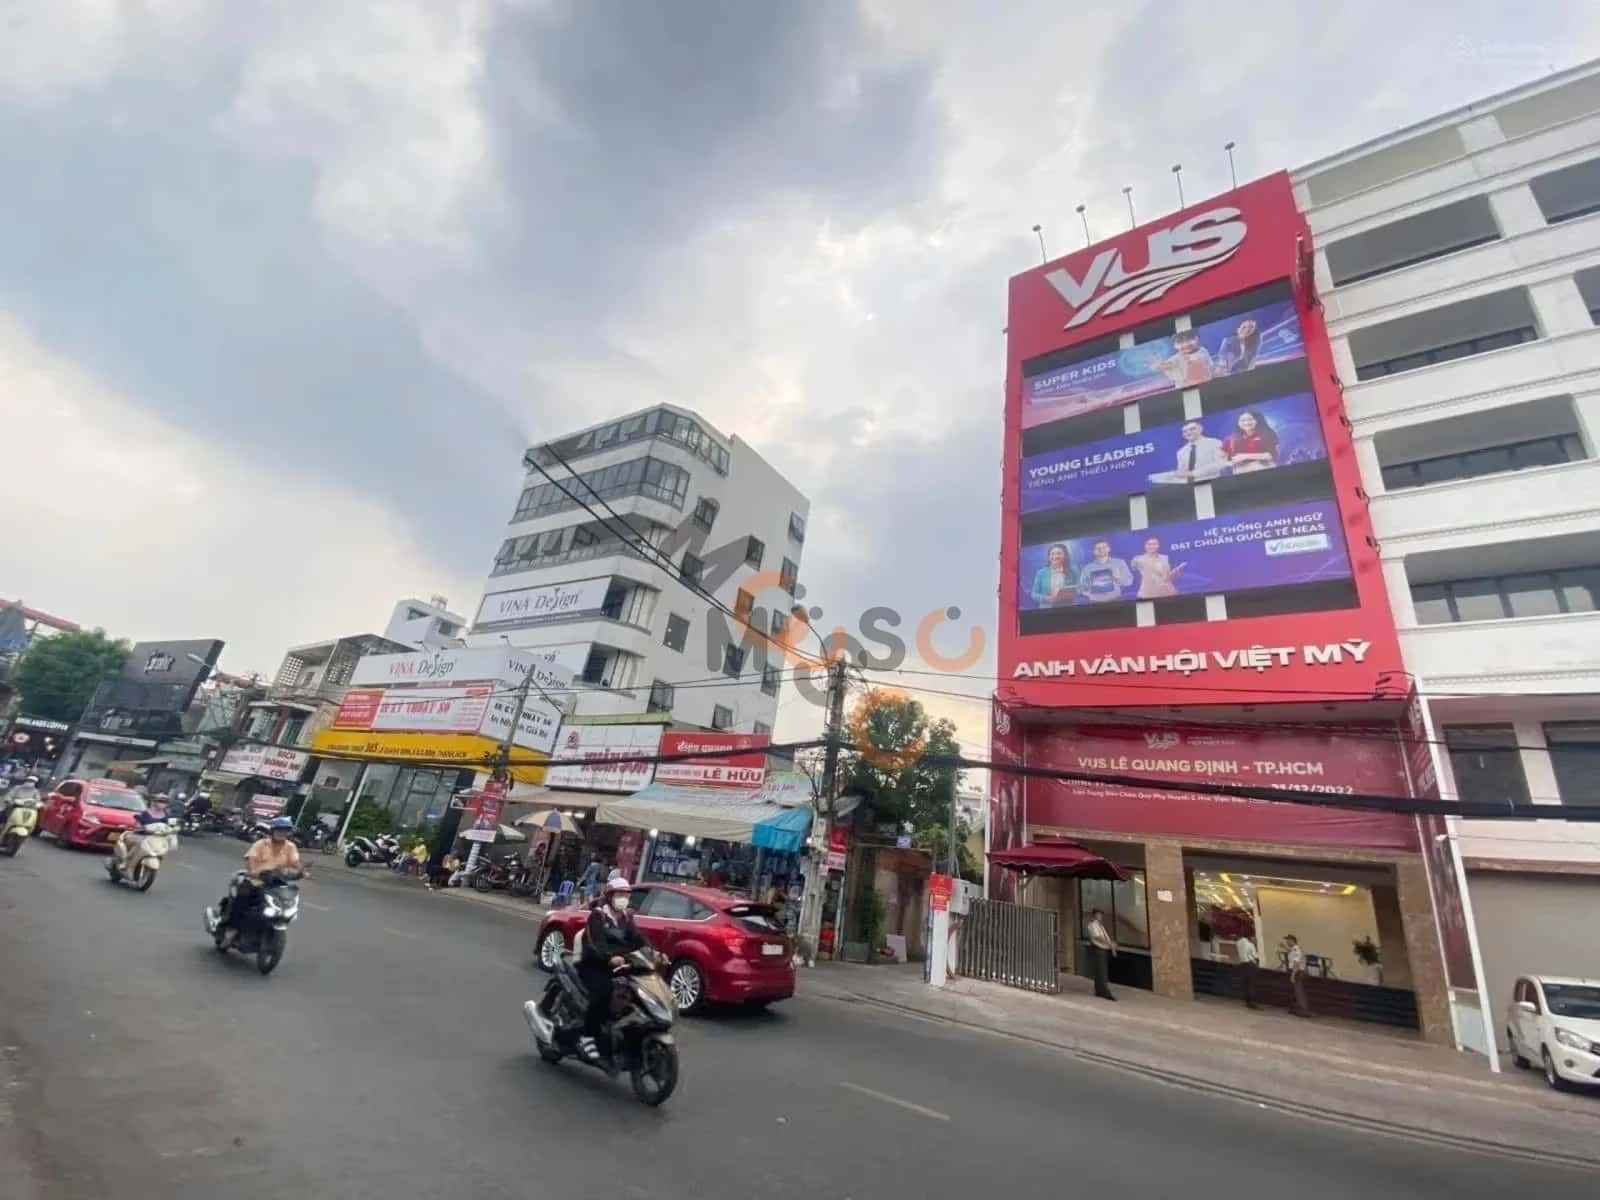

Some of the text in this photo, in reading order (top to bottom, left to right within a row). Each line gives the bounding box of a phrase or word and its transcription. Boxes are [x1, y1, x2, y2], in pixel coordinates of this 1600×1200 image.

[1044, 207, 1248, 312] VUS
[1034, 370, 1080, 391] SUPER
[1082, 359, 1118, 376] KIDS
[1029, 443, 1155, 478] YOUNG LEADERS
[1265, 518, 1292, 528] ANH
[1292, 523, 1326, 534] NEAS
[500, 598, 529, 614] VINA
[1013, 638, 1372, 678] ANH VĂN HỘI VIỆT MỸ
[390, 661, 414, 676] VINA
[703, 767, 721, 780] LÊ
[728, 767, 763, 782] HỮU
[1078, 757, 1106, 769] VUS
[1111, 755, 1128, 770] LÊ
[1132, 760, 1191, 773] QUANG
[1194, 760, 1238, 776] ĐỊNH
[1254, 761, 1324, 775] TP.HCM
